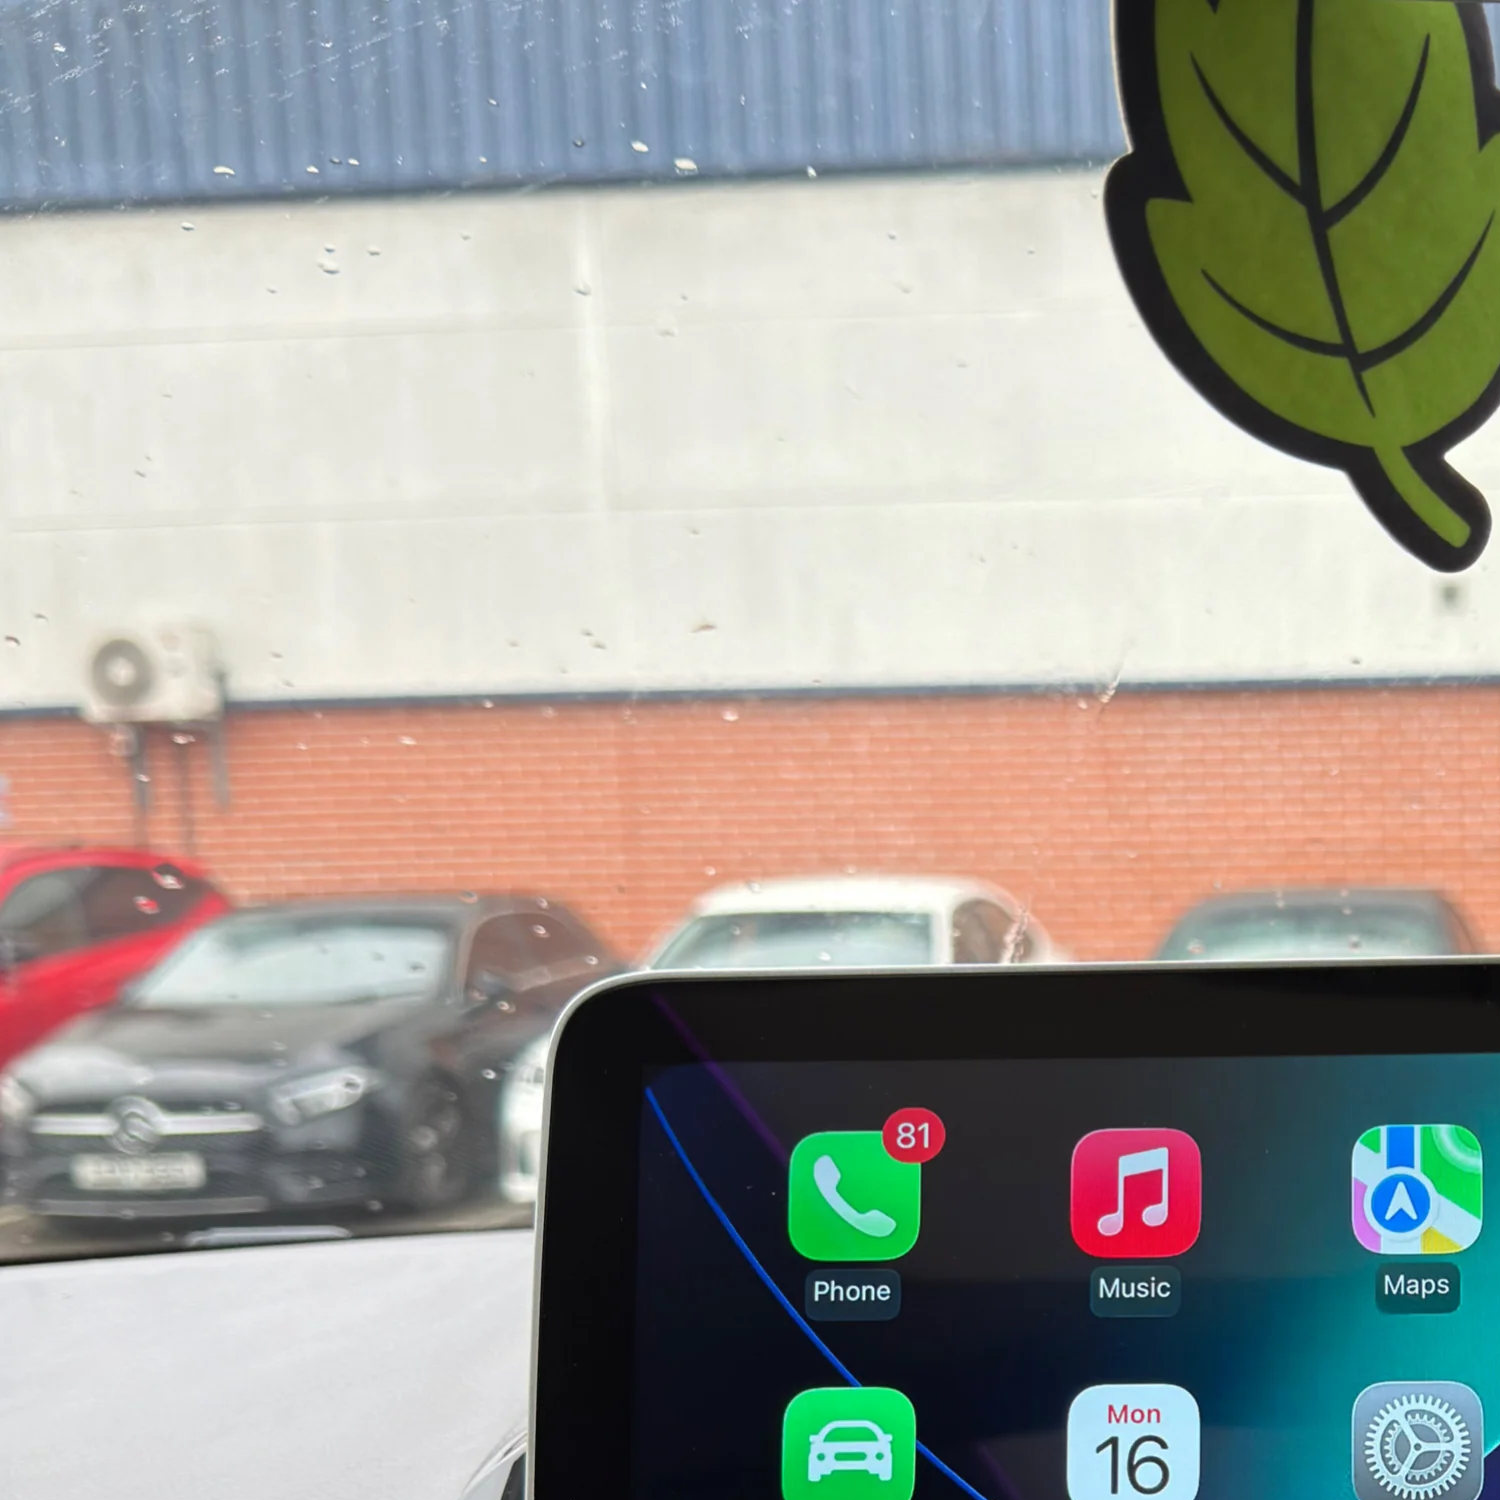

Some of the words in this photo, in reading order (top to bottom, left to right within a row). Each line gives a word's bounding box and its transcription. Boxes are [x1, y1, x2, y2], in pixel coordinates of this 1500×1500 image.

[896, 1122, 929, 1149] 81
[814, 1279, 891, 1302] Phone
[1099, 1276, 1171, 1299] Music
[1384, 1274, 1450, 1299] Maps
[1107, 1404, 1161, 1424] Mon
[1095, 1434, 1170, 1495] 16
